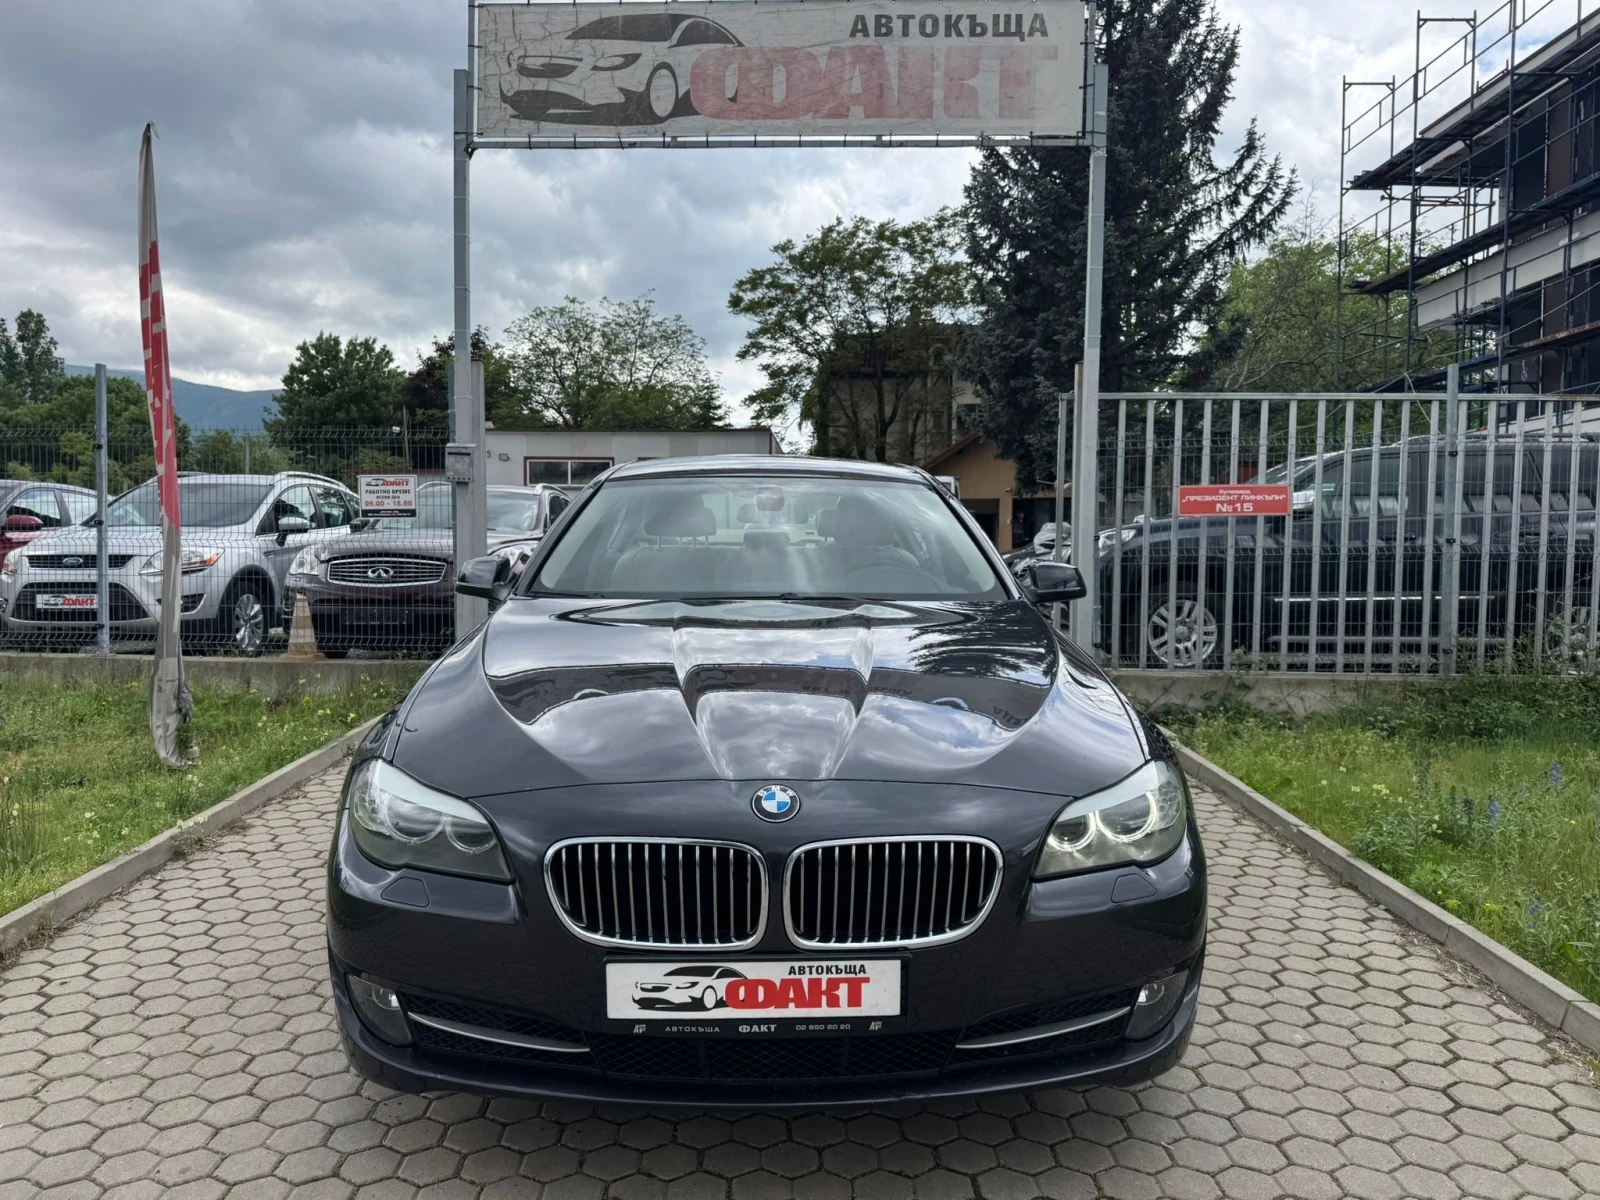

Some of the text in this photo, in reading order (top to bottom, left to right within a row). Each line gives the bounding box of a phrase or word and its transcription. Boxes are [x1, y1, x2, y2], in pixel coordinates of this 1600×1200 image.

[849, 13, 1049, 41] АВТОКЪЩА
[690, 45, 1059, 120] ФАКТ
[757, 785, 796, 797] BMW
[788, 964, 867, 977] АВТОКЪЩА
[725, 977, 871, 1010] ФАКТ
[738, 1024, 778, 1033] ФАКТ
